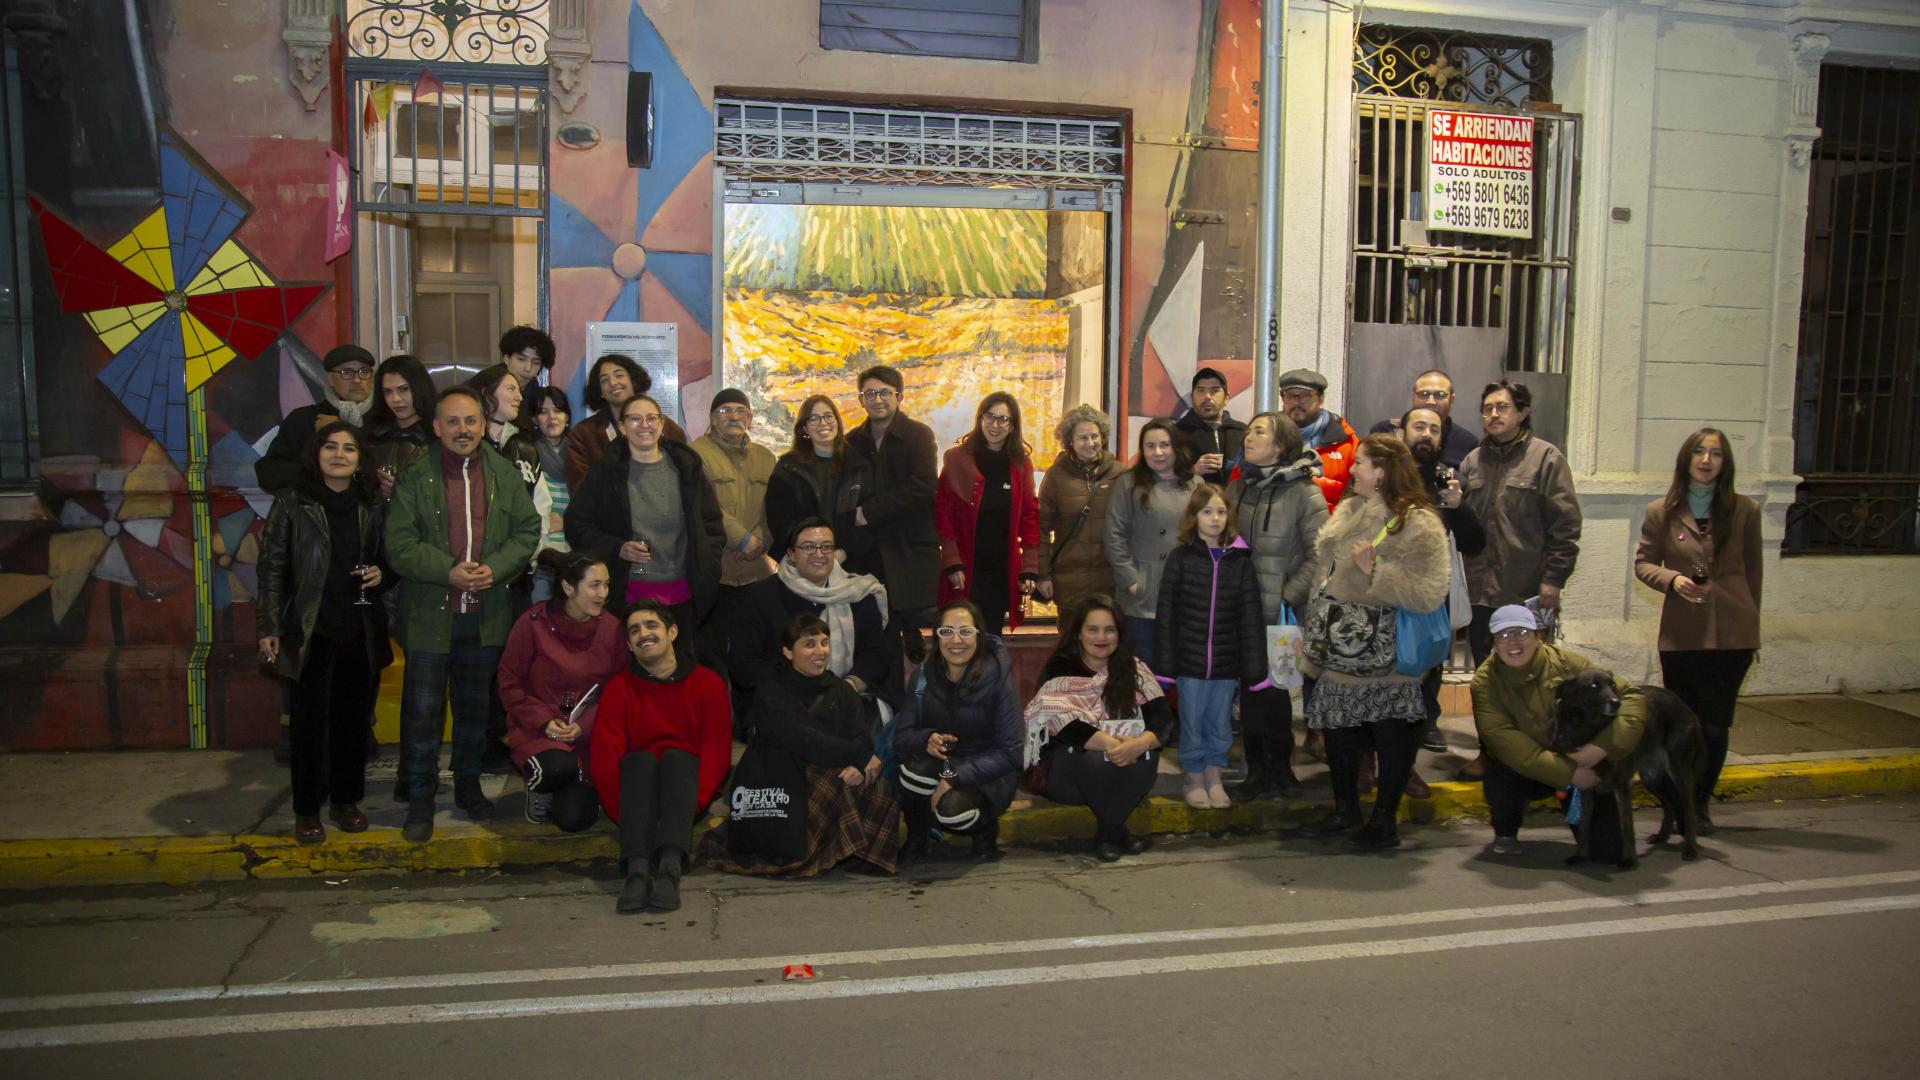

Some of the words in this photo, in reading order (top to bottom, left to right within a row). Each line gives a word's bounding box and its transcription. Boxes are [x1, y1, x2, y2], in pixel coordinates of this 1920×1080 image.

[1433, 114, 1451, 137] SE
[1454, 116, 1531, 142] ARRIENDAN
[1433, 140, 1532, 168] HABITACIONES
[1438, 166, 1469, 177] SOLO
[1473, 169, 1526, 181] ADULTOS
[1445, 181, 1471, 202] +569
[1474, 182, 1499, 204] 5801
[1504, 184, 1529, 205] 6436
[1445, 205, 1471, 226] +569
[1474, 206, 1500, 228] 9679
[1503, 208, 1529, 230] 6238
[744, 793, 790, 804] TEATRO
[745, 788, 785, 797] FESTIVAL
[754, 801, 777, 809] CASA
